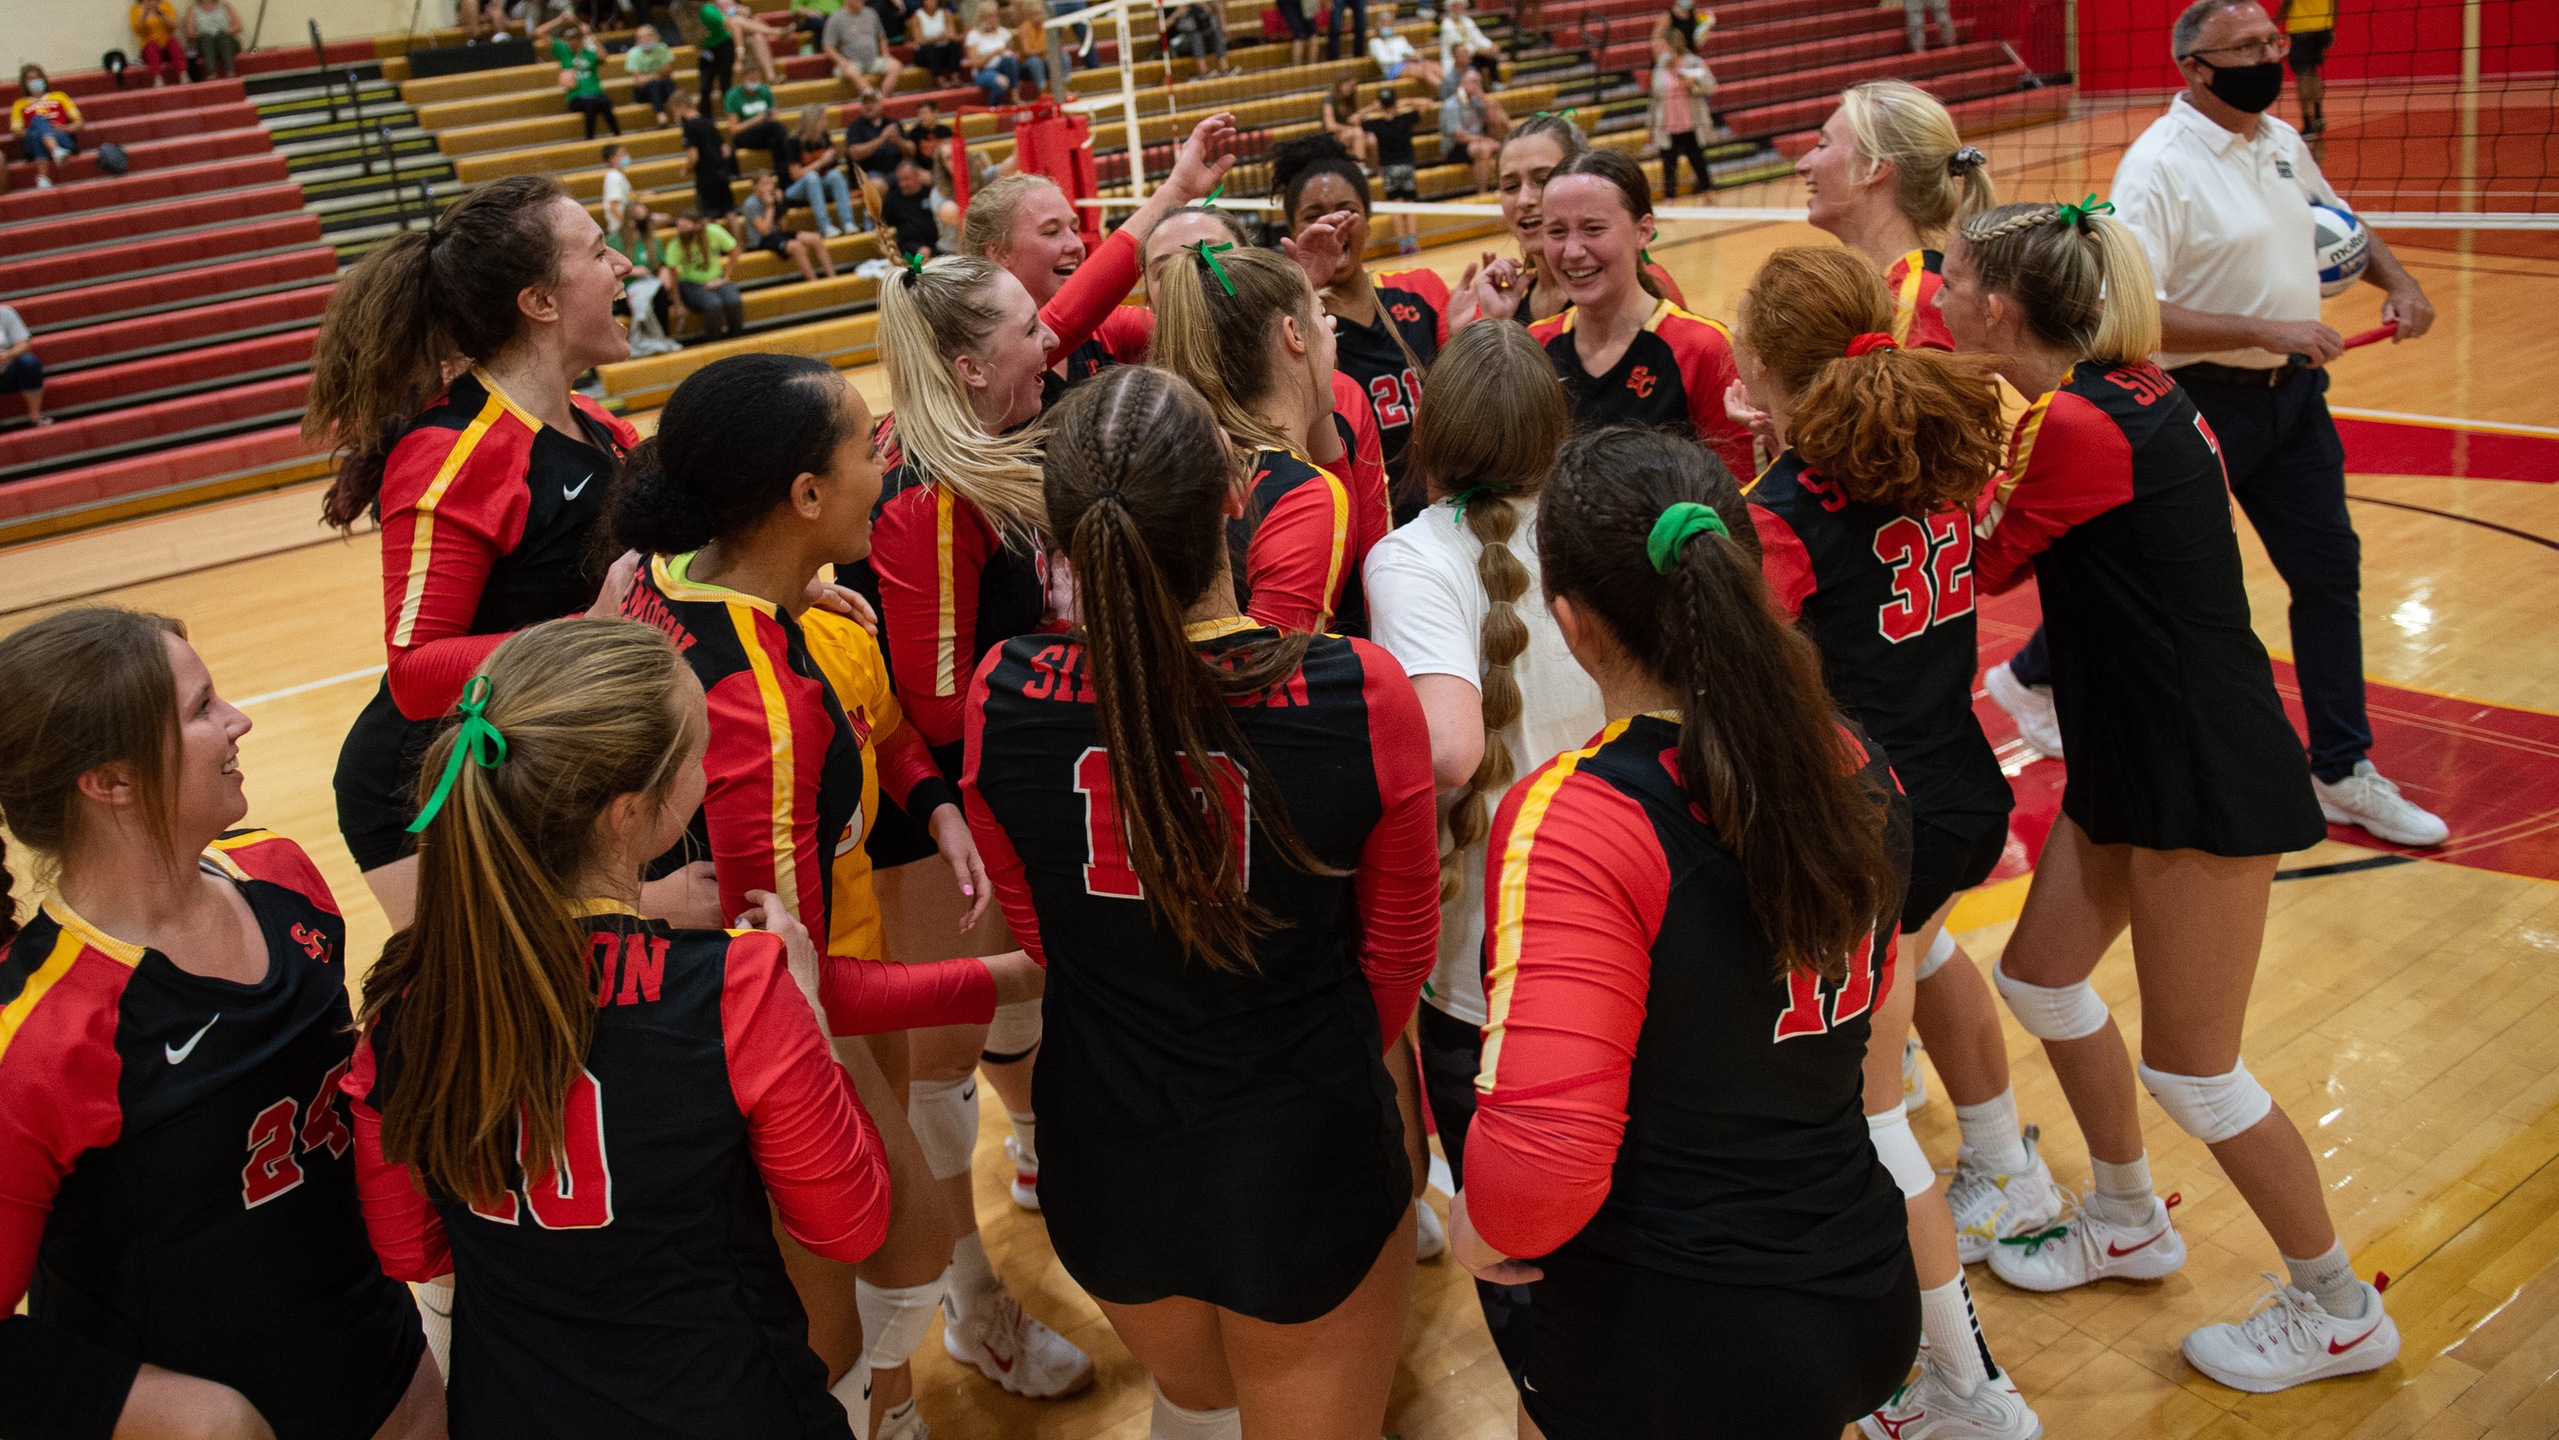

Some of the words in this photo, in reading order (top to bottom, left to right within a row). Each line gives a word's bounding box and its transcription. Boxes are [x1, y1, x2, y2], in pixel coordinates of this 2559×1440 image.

[1369, 366, 1423, 430] 21
[1626, 365, 1657, 398] SC
[1872, 500, 1975, 645] 32
[242, 1055, 351, 1210] 24
